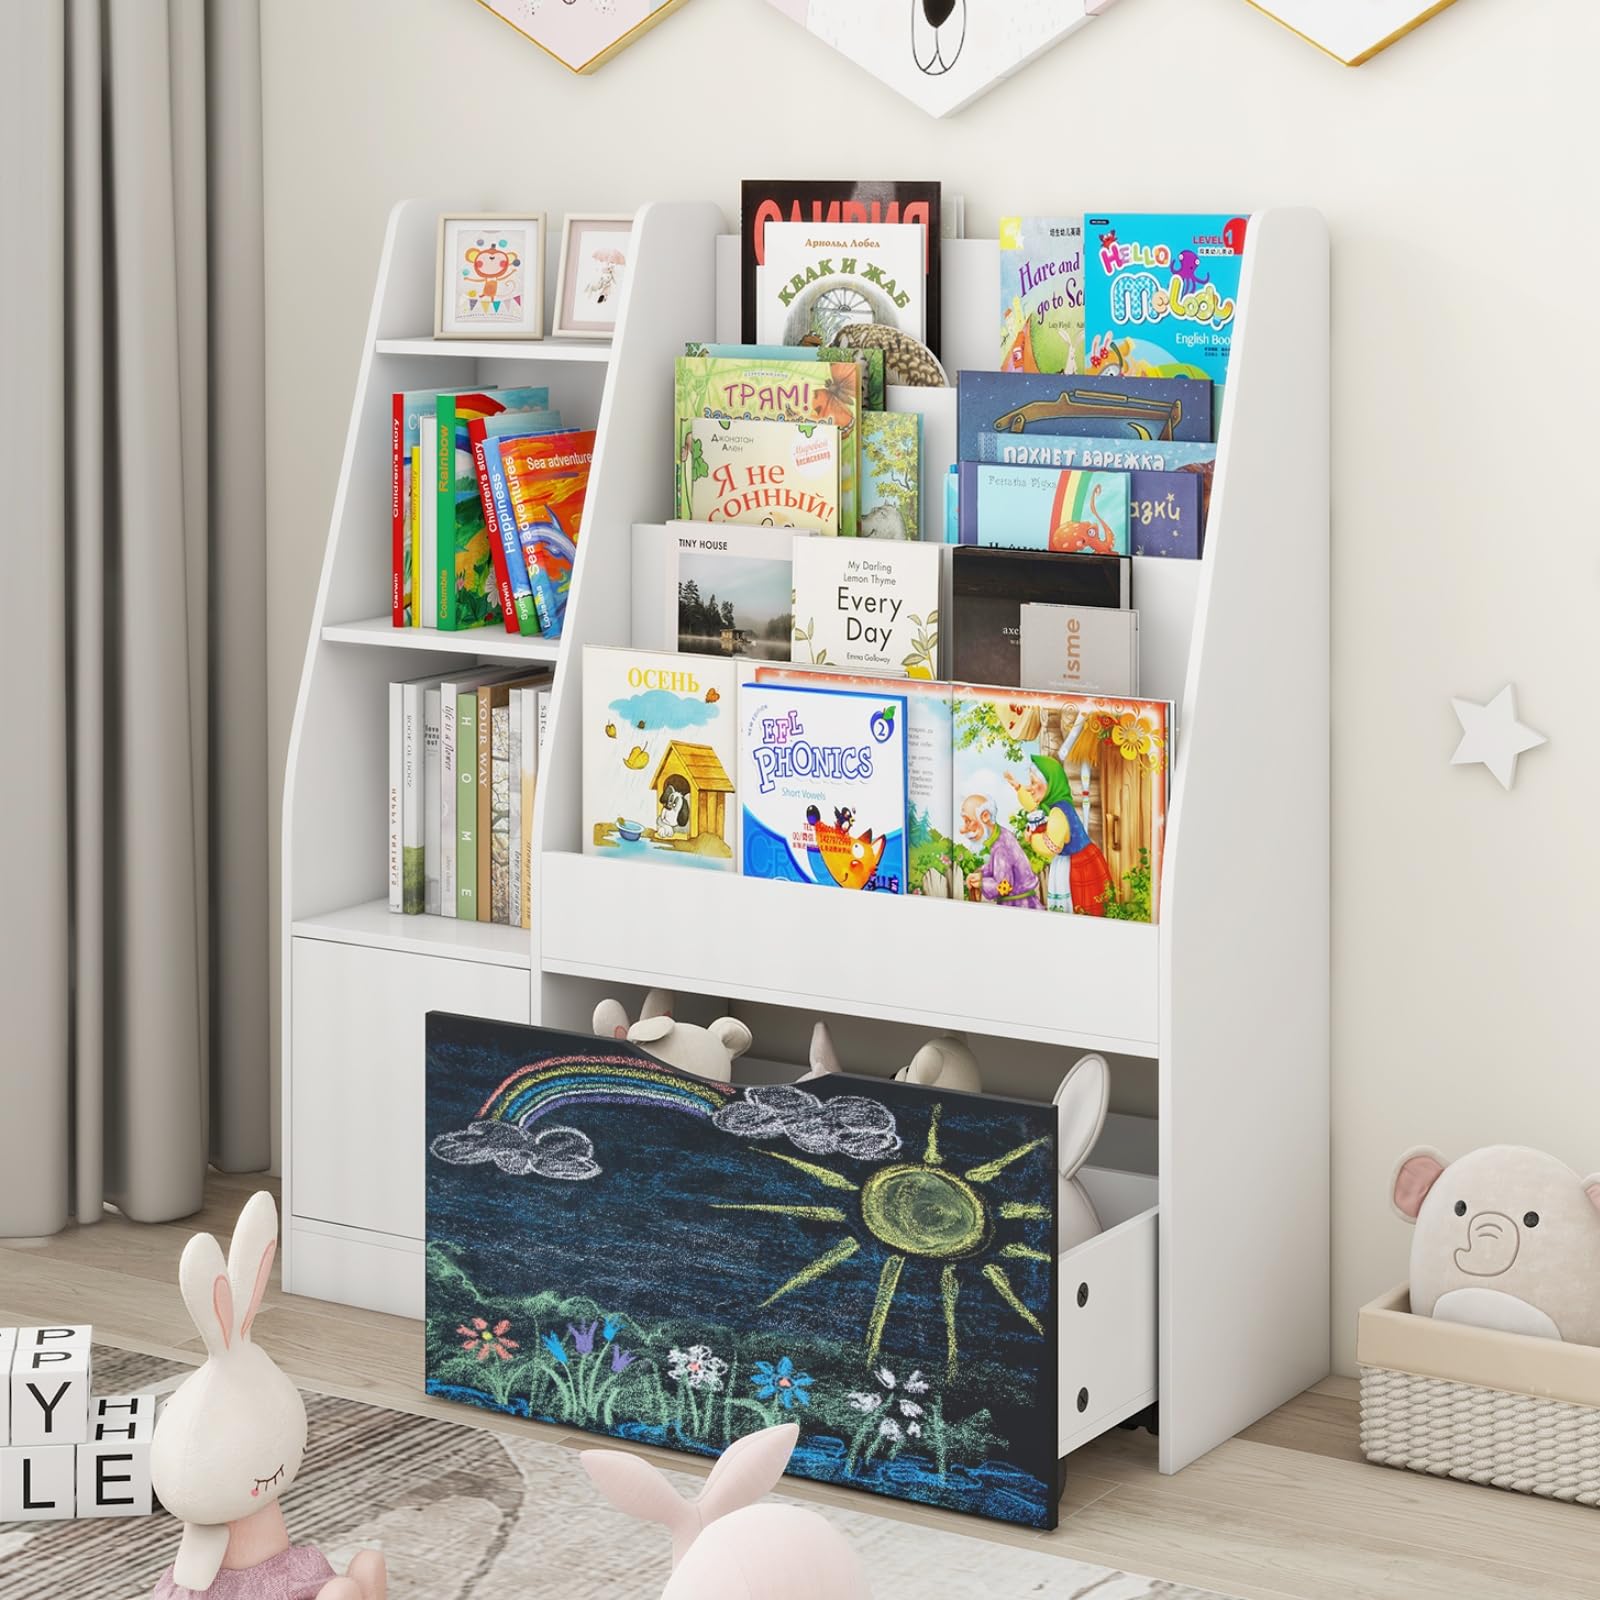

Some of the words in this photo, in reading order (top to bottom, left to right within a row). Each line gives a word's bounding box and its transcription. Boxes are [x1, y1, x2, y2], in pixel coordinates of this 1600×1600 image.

[805, 238, 848, 249] Арнольд
[850, 238, 880, 248] Лобел
[1193, 235, 1223, 245] LEVEL
[1224, 229, 1233, 245] 1
[1018, 260, 1056, 297] Hare
[1058, 252, 1080, 274] and
[1100, 243, 1170, 275] HELLO
[778, 258, 835, 307] КВАК
[840, 257, 857, 274] И
[861, 262, 910, 308] ЖАБ
[1037, 299, 1050, 325] go
[1053, 291, 1063, 309] to
[1066, 277, 1084, 308] Sc
[1175, 332, 1208, 347] English
[1212, 334, 1231, 345] Boo
[724, 383, 809, 412] ТРЯМ!
[438, 424, 449, 493] Rainbow
[475, 442, 486, 471] story
[527, 456, 547, 471] Sea
[548, 451, 592, 468] adventure
[712, 462, 737, 499] Я
[745, 463, 785, 486] не
[480, 473, 498, 533] Children's
[493, 472, 516, 554] Happiness
[505, 455, 533, 542] adventures
[1131, 493, 1180, 525] азки
[525, 544, 540, 576] Sea
[678, 538, 697, 548] TINY
[699, 539, 728, 551] HOUSE
[843, 573, 869, 583] Lemon
[871, 574, 897, 588] Thyme
[848, 560, 860, 572] My
[862, 560, 892, 574] Darling
[501, 581, 513, 616] Darwin
[517, 587, 528, 621] Sydney
[536, 585, 551, 629] Louisiana
[837, 586, 903, 623] Every
[846, 616, 893, 652] Day
[1002, 625, 1021, 636] axe
[846, 652, 864, 662] Emma
[864, 653, 891, 664] Galloway
[627, 667, 700, 693] ОСЕНЬ
[479, 697, 488, 745] YOUR
[762, 710, 804, 744] EFL
[877, 722, 886, 737] 2
[479, 751, 488, 788] WAY
[752, 740, 874, 794] PHONICS
[781, 786, 801, 798] Short
[802, 788, 826, 801] Vowels
[36, 1328, 76, 1345] P
[32, 1351, 72, 1369] P
[26, 1381, 72, 1433] Y
[98, 1398, 139, 1416] H
[95, 1422, 136, 1441] H
